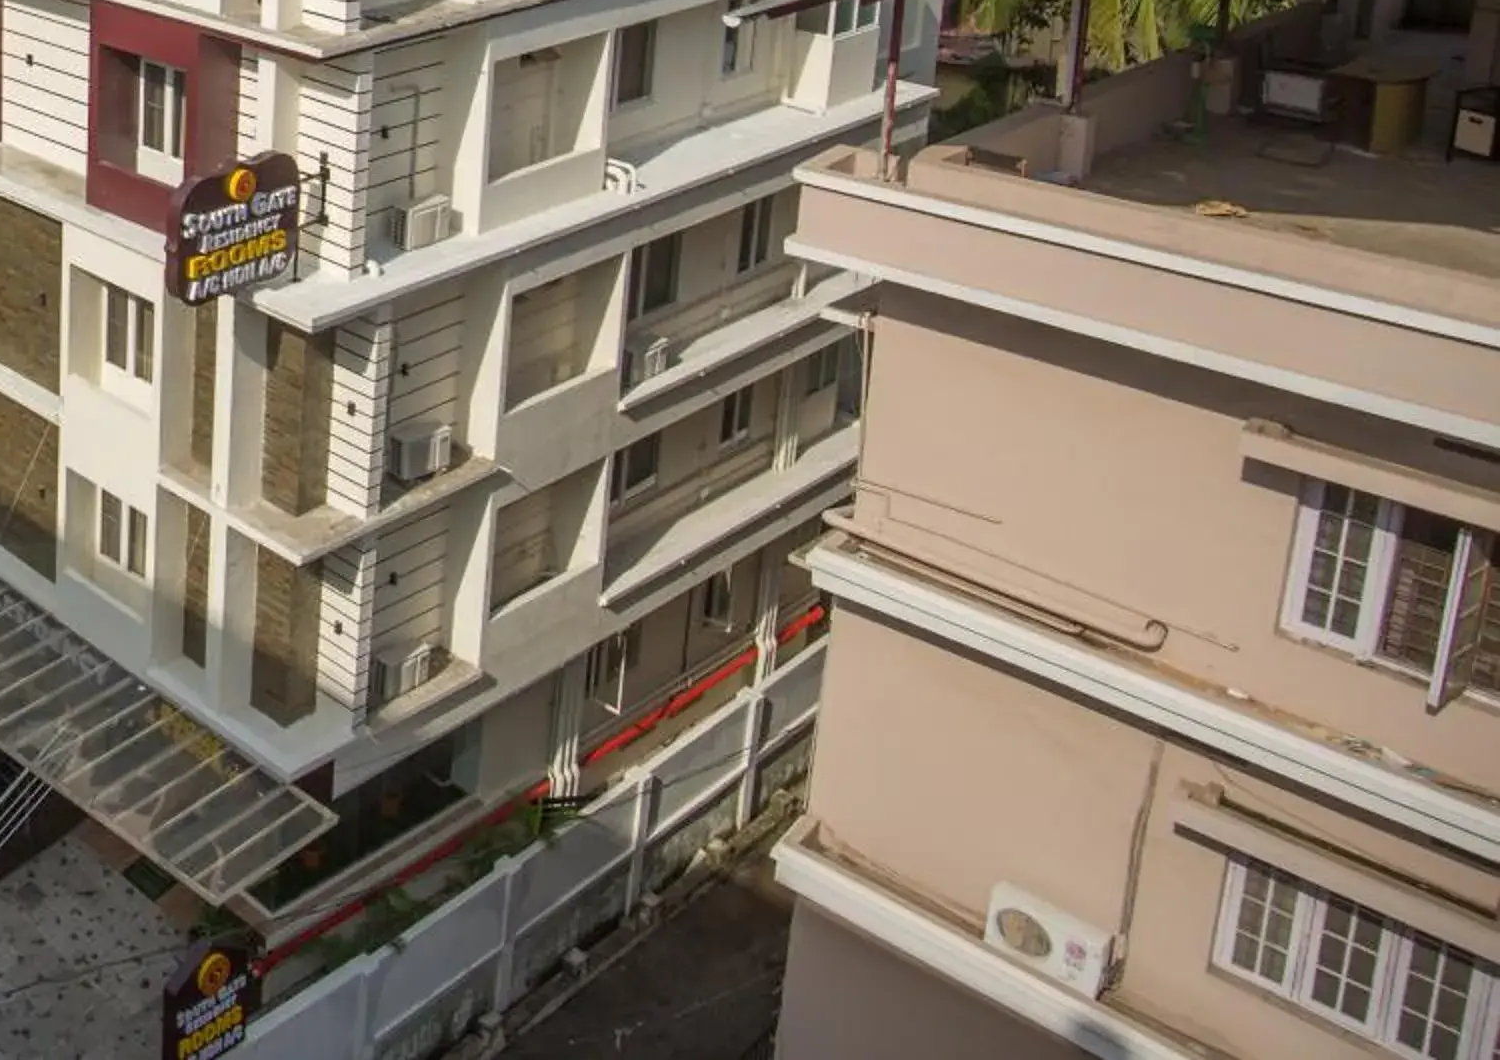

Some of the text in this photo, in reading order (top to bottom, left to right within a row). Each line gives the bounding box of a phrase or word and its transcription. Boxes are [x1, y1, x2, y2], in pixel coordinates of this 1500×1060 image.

[182, 185, 297, 240] SOUTH GATE
[187, 229, 287, 279] ROOMS
